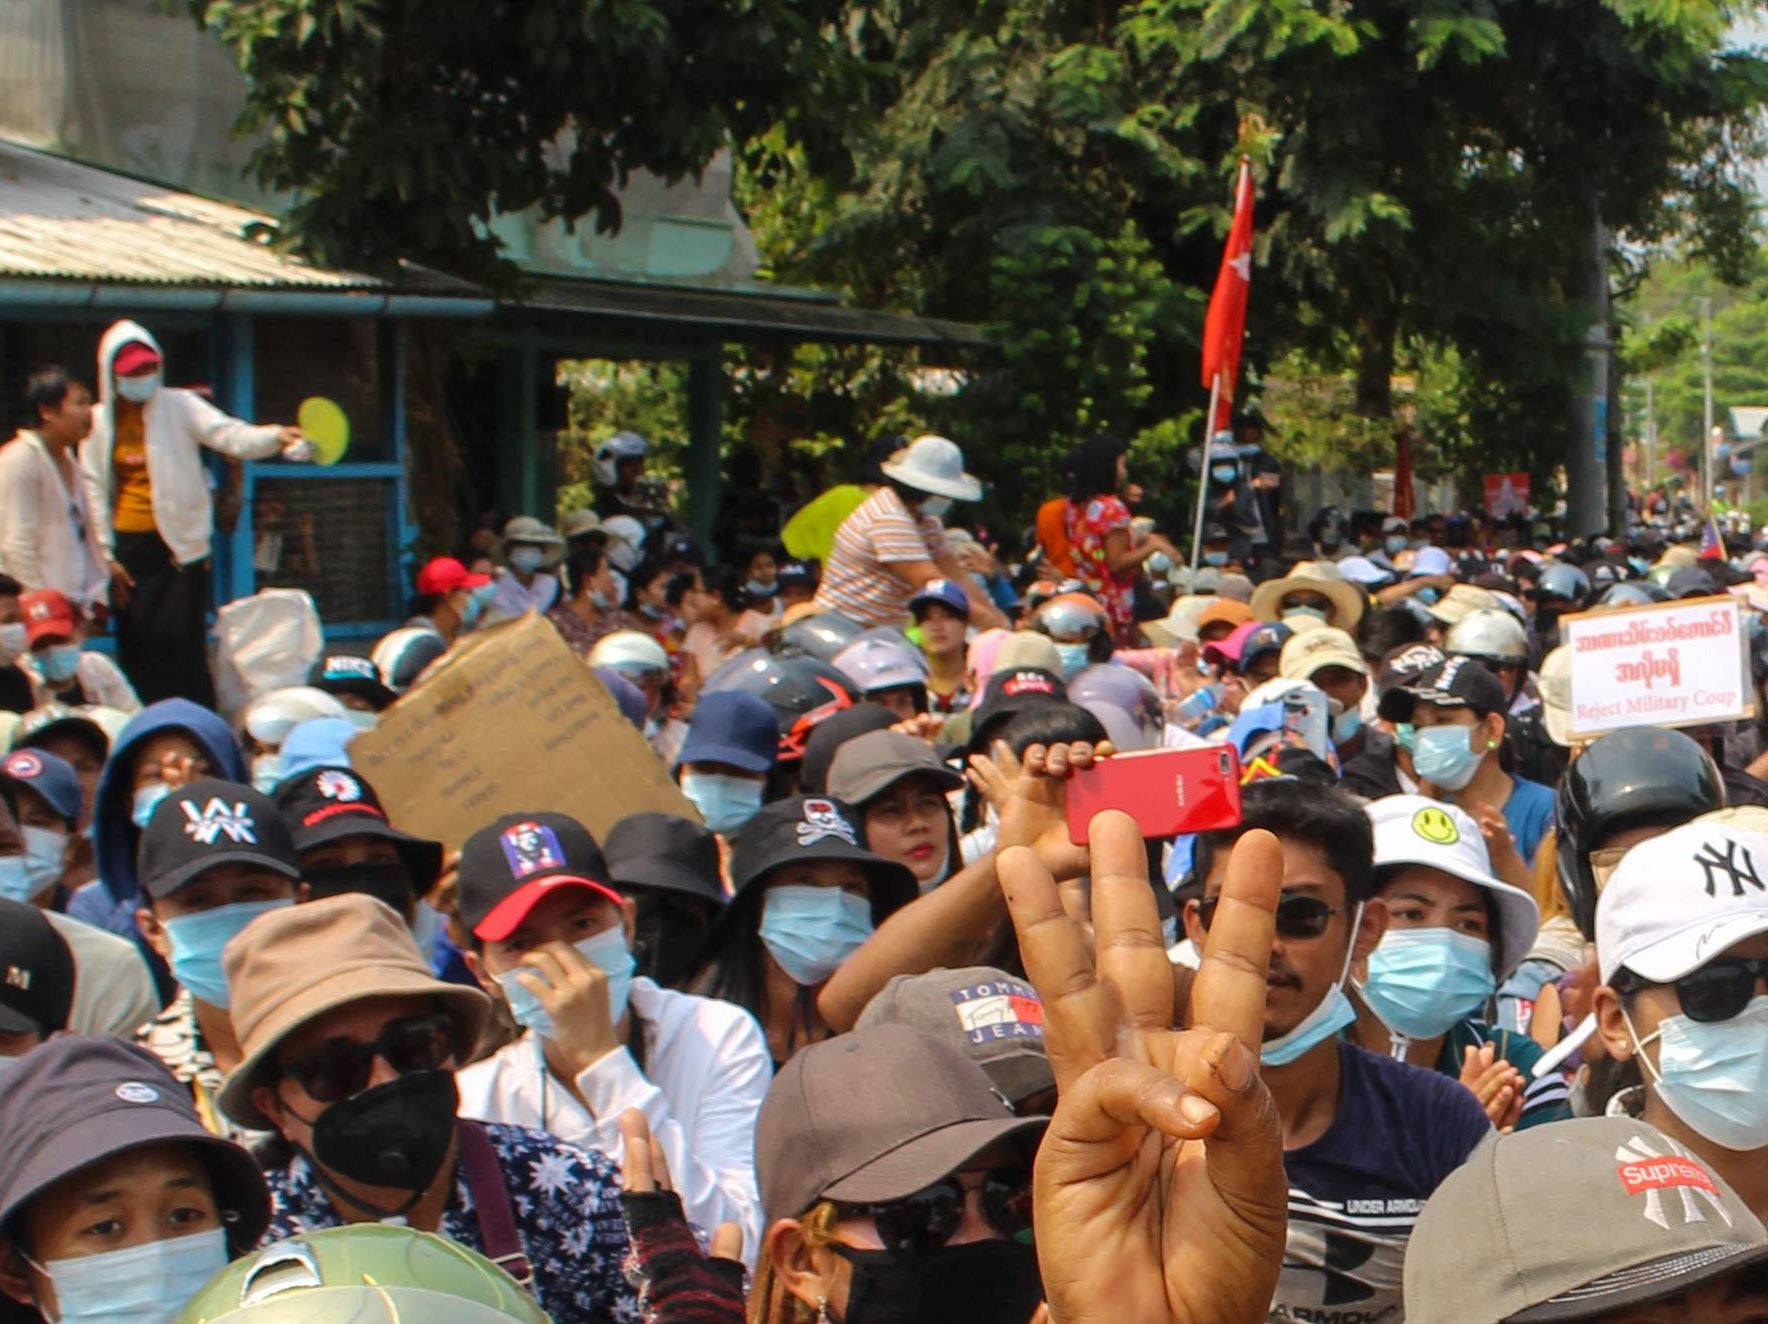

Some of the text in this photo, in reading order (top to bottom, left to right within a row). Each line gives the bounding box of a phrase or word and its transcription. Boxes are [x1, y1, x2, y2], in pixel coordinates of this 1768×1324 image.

[1577, 688, 1736, 721] Reject Military Coup
[1693, 838, 1766, 898] NY
[971, 1023, 1043, 1044] JEAN
[1346, 1199, 1385, 1214] UNDER
